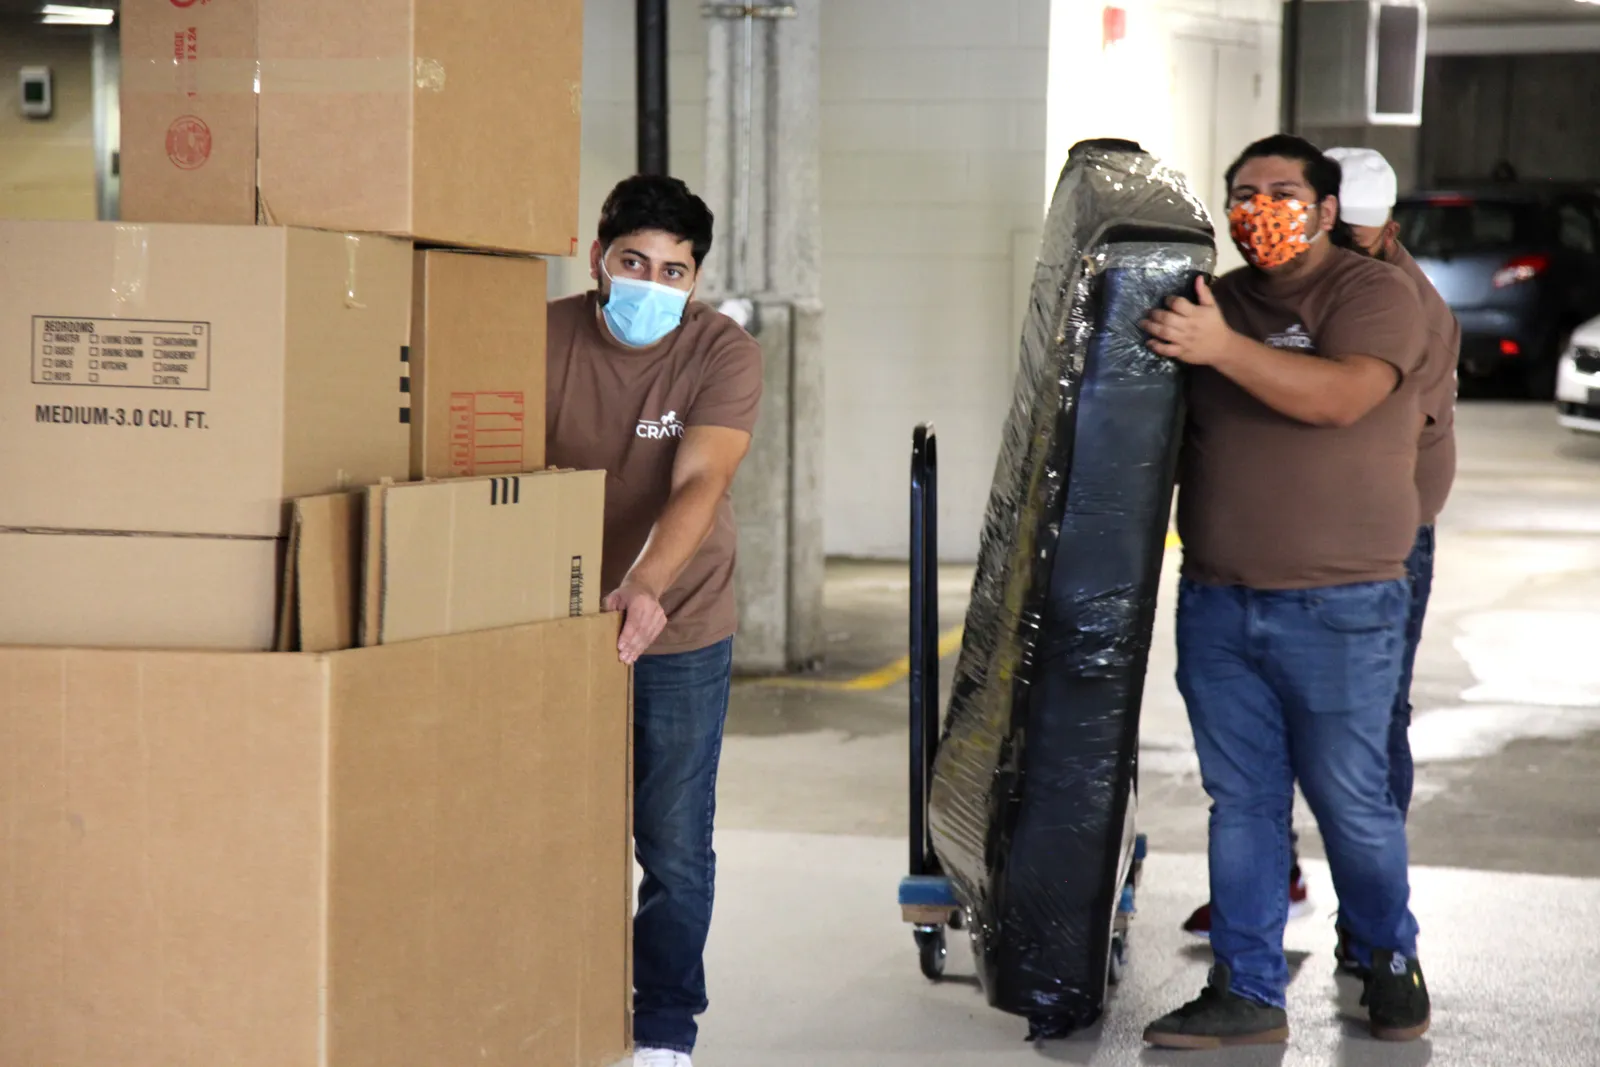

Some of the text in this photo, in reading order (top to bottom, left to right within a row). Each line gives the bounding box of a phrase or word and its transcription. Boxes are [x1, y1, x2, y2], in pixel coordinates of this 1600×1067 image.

[174, 31, 185, 63] ARGE
[44, 320, 95, 333] BEDROOMS
[35, 404, 209, 429] MEDIUM-3.0 CU. FT.
